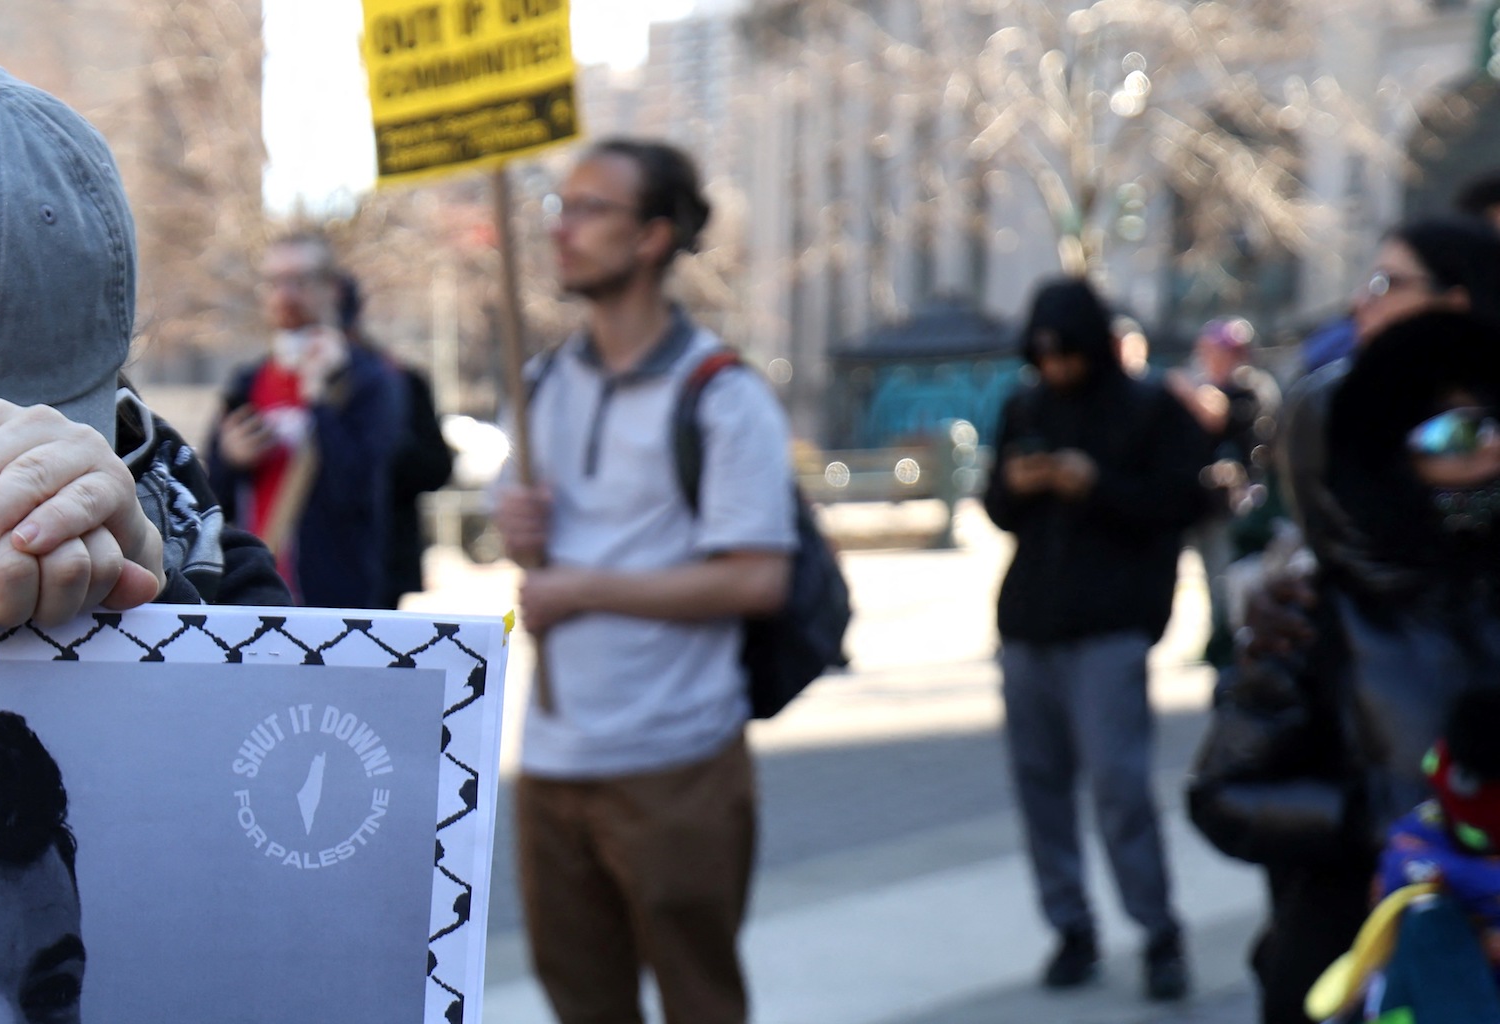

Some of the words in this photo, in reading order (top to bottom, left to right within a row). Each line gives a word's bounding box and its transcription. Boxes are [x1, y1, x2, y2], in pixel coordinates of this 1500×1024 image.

[232, 713, 285, 778] SHUT
[288, 703, 313, 735] IT
[319, 704, 394, 778] DOWN!
[233, 788, 268, 849] FOR
[264, 788, 390, 870] PALESTINE
